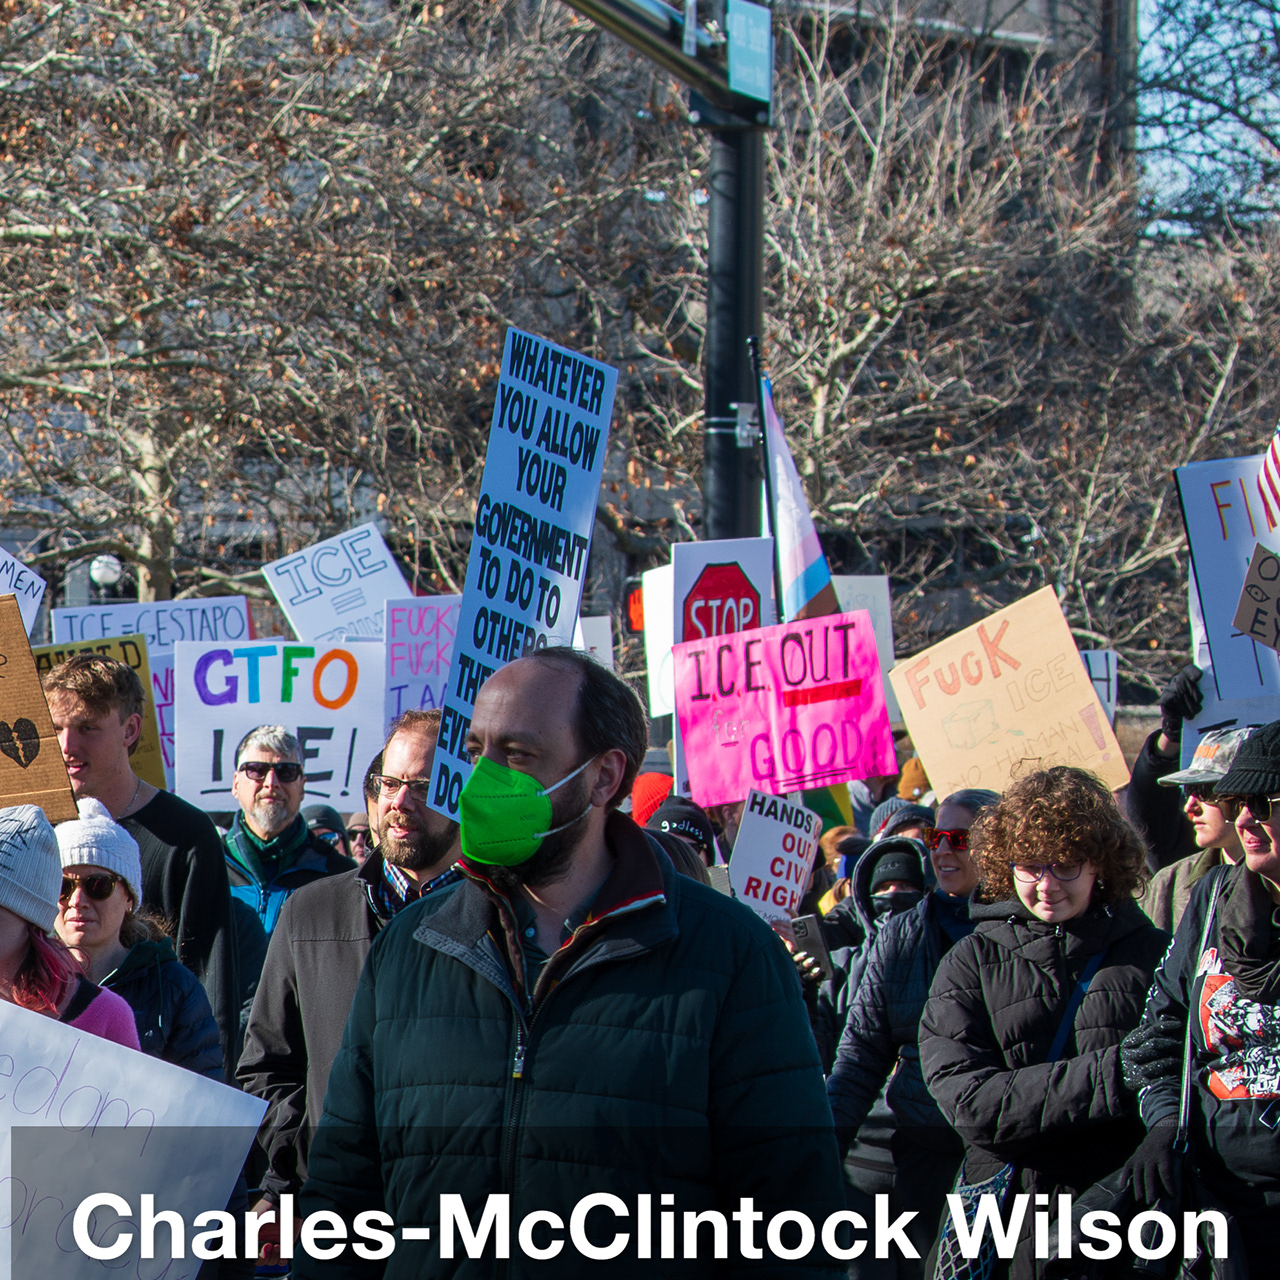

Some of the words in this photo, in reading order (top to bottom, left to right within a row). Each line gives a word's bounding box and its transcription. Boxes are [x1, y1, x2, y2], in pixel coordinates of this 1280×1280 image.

[509, 332, 606, 416] WHATEVER
[498, 382, 538, 440] YOU
[536, 406, 601, 472] ALLOW
[516, 446, 567, 513] YOUR
[274, 530, 388, 606] ICE
[476, 493, 589, 581] GOVERNMENT
[476, 545, 501, 599] TO
[505, 558, 535, 611] DO
[537, 579, 561, 628] TO
[137, 605, 246, 646] GESTAPO
[391, 605, 455, 637] FUCK
[691, 597, 754, 639] STOP
[194, 644, 358, 710] GTFO
[391, 641, 451, 677] FUCK
[782, 623, 856, 686] OUT
[1006, 653, 1076, 712] ICE
[712, 710, 749, 741] for
[750, 719, 864, 781] GOOD
[995, 716, 1079, 772] HUMAN
[212, 727, 357, 796] IE!
[434, 762, 462, 814] DO
[750, 793, 814, 834] HANDS
